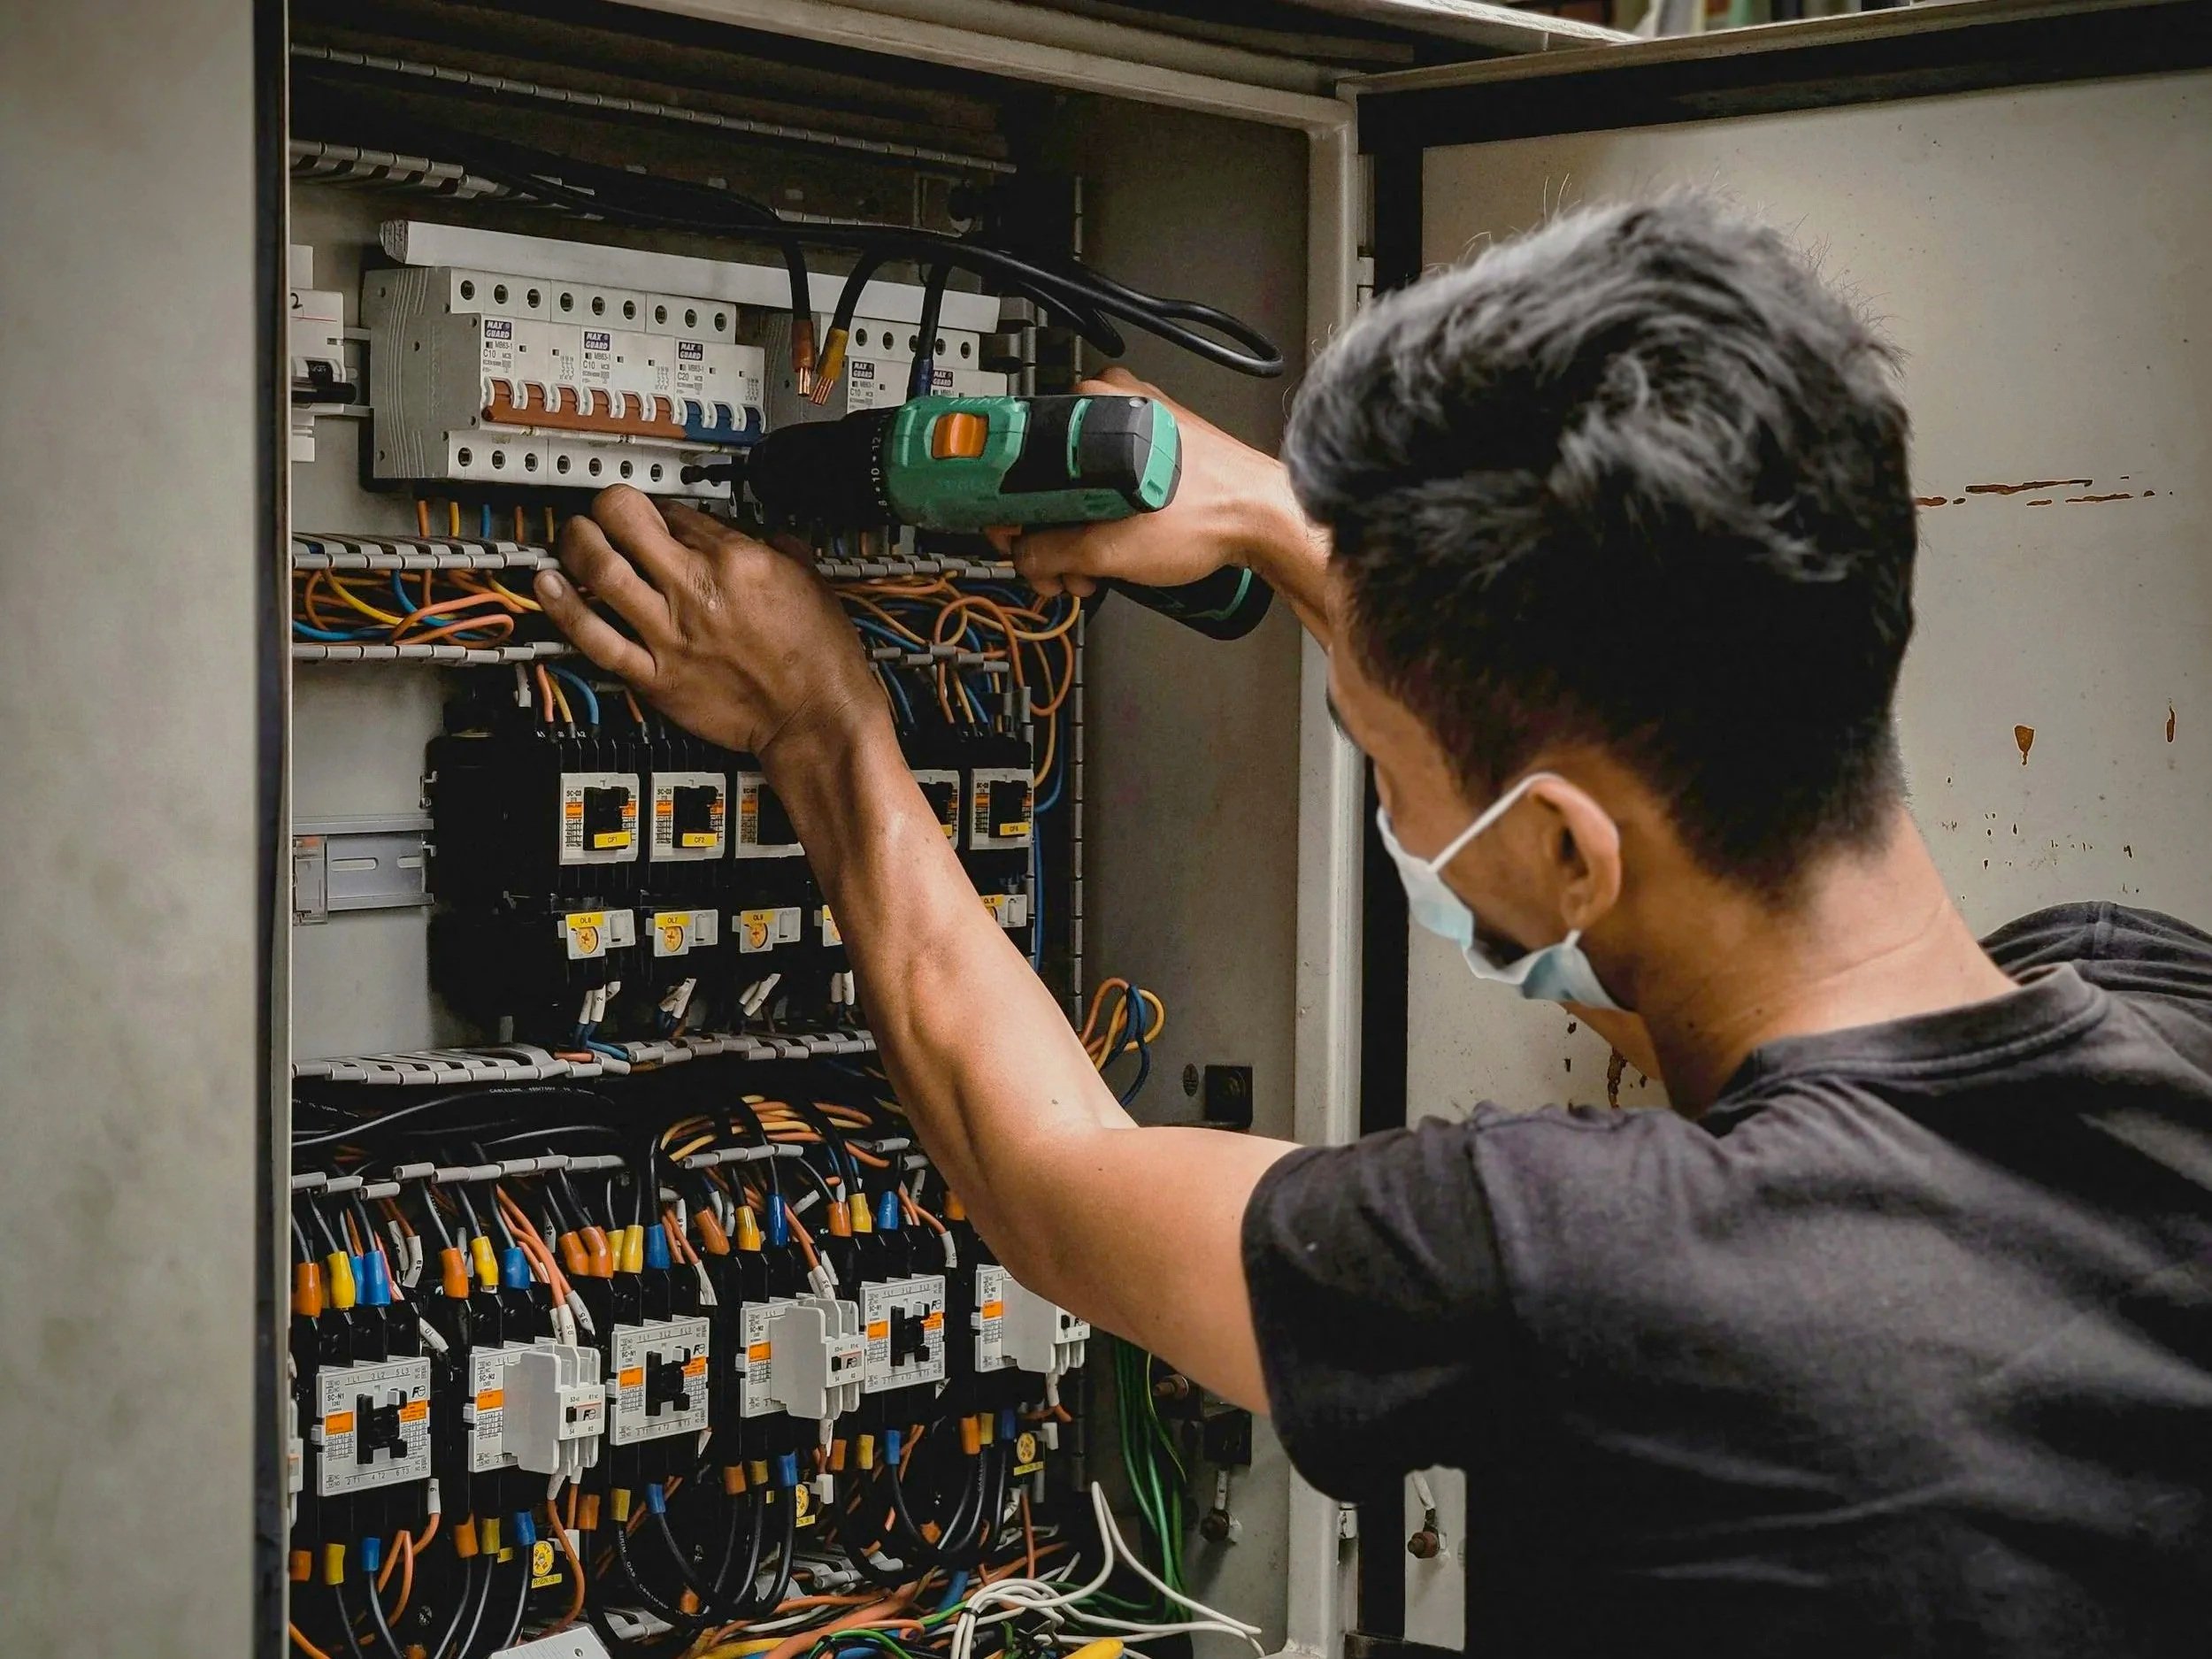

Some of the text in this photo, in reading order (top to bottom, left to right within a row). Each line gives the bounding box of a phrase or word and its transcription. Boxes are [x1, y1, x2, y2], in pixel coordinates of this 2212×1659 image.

[487, 321, 503, 330] MAX
[585, 341, 608, 349] GUARD
[483, 349, 496, 358] C10
[680, 351, 702, 360] GUARD
[582, 360, 595, 369] C10
[677, 373, 689, 381] C20
[933, 378, 952, 387] GUARD
[872, 437, 881, 451] 12
[871, 468, 880, 482] 10
[579, 1312, 588, 1324] 35
